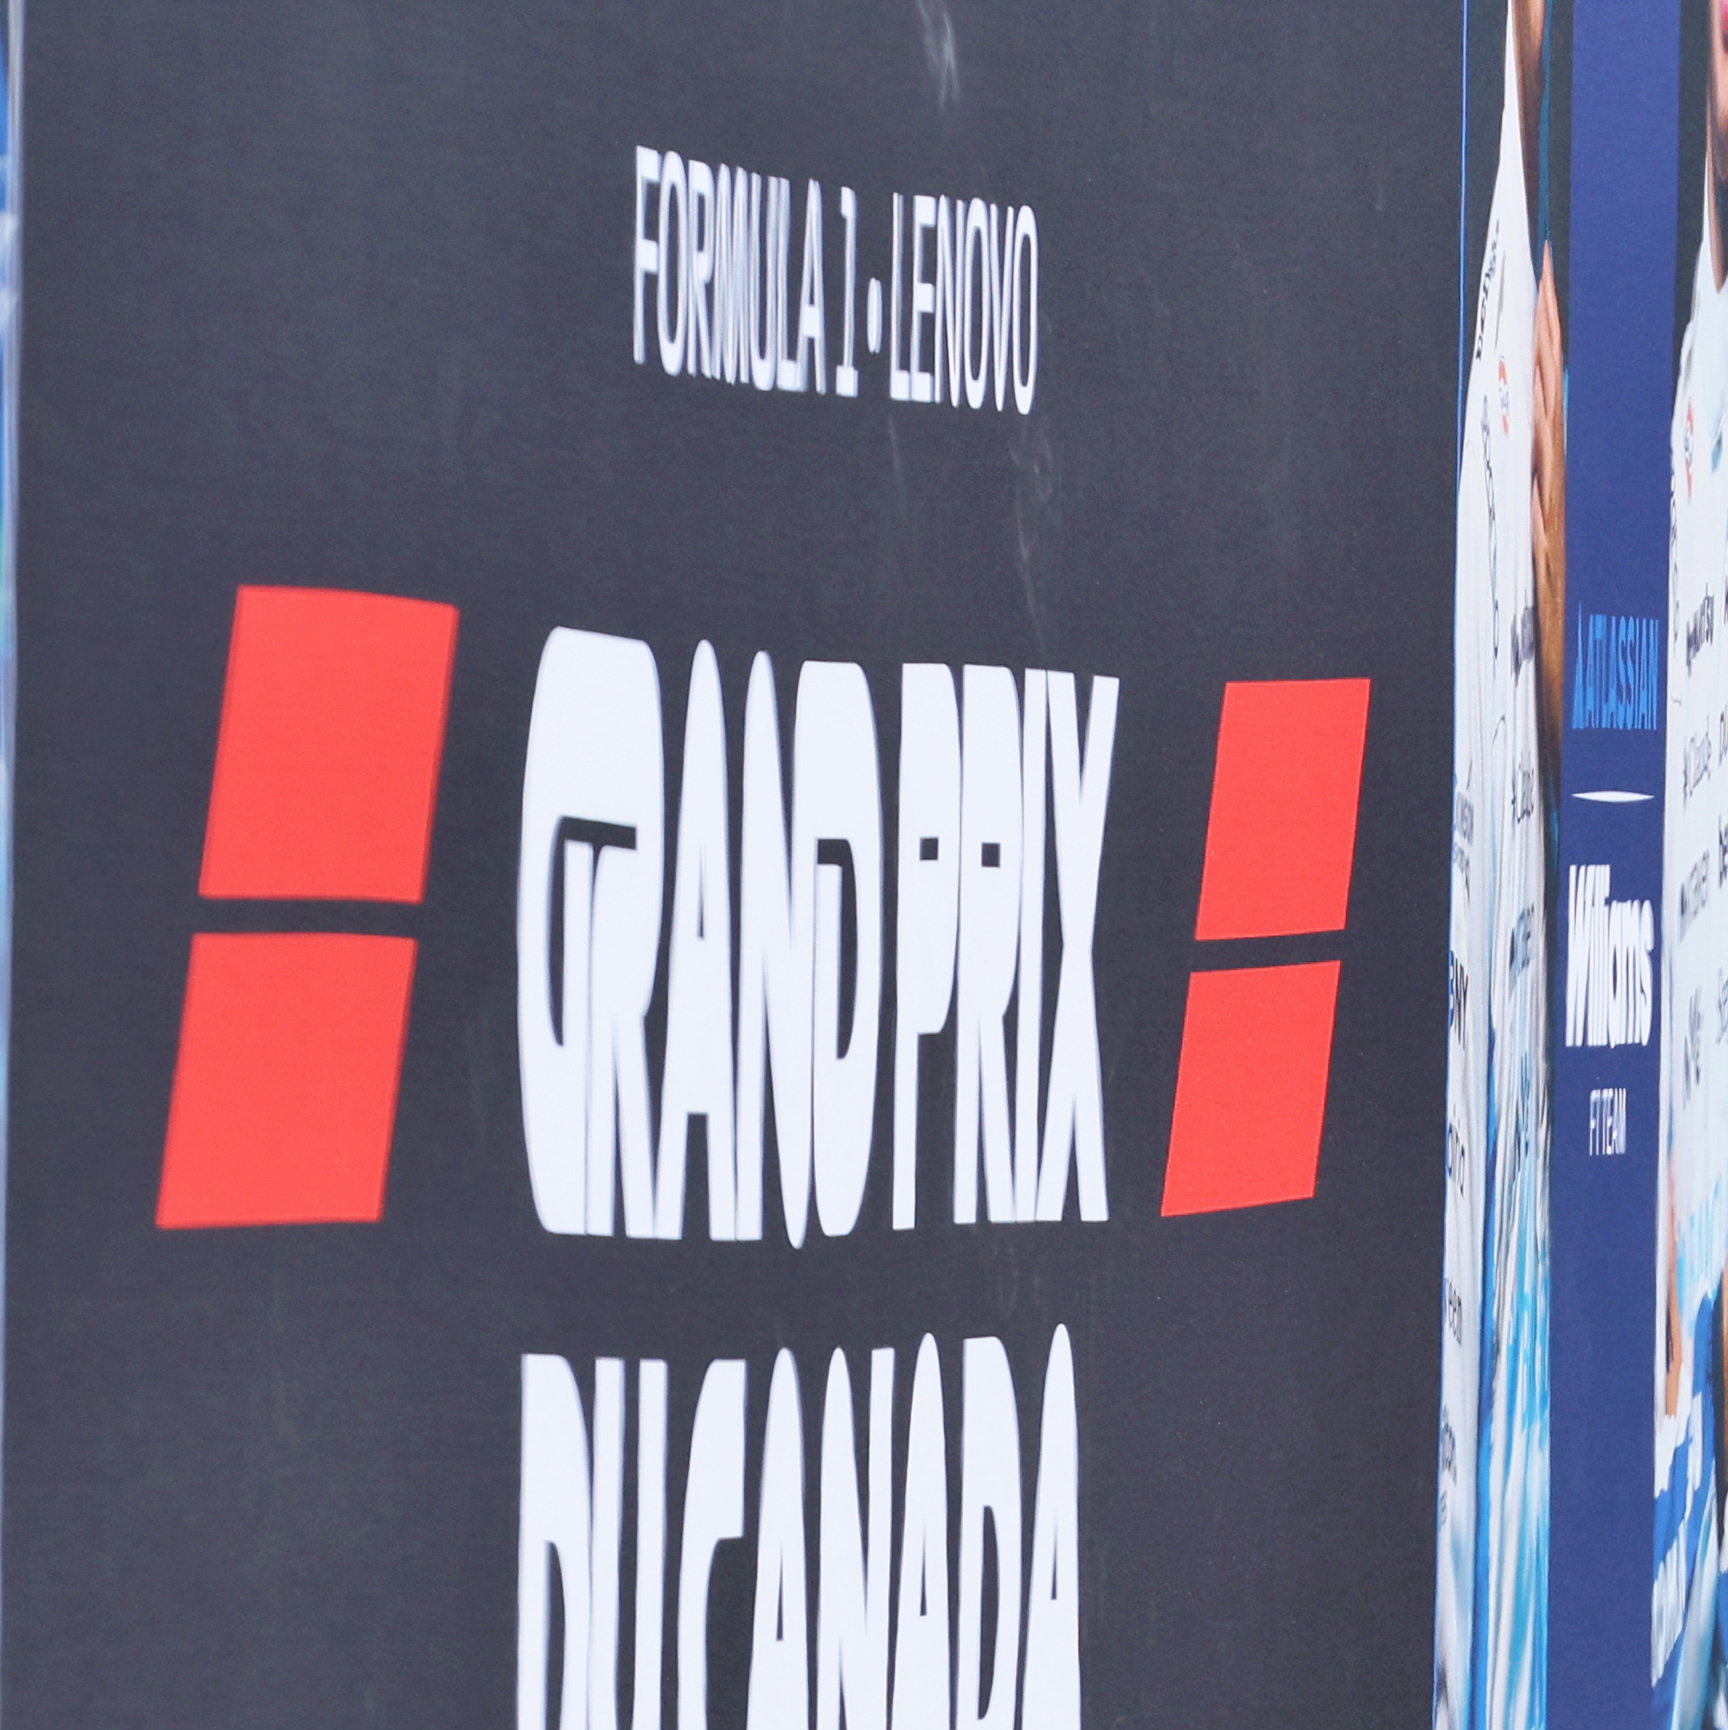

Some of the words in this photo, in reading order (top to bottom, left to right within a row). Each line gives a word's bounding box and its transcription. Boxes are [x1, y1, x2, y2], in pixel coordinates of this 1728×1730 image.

[633, 145, 826, 395] FORMULA
[835, 186, 859, 398] 1
[889, 192, 1038, 415] LENOVO
[1585, 614, 1658, 730] ATLASSIAN
[516, 626, 883, 1249] GRAND
[892, 662, 1120, 1231] PRIX
[1565, 864, 1654, 1049] Williams
[1601, 1087, 1627, 1157] TEAM
